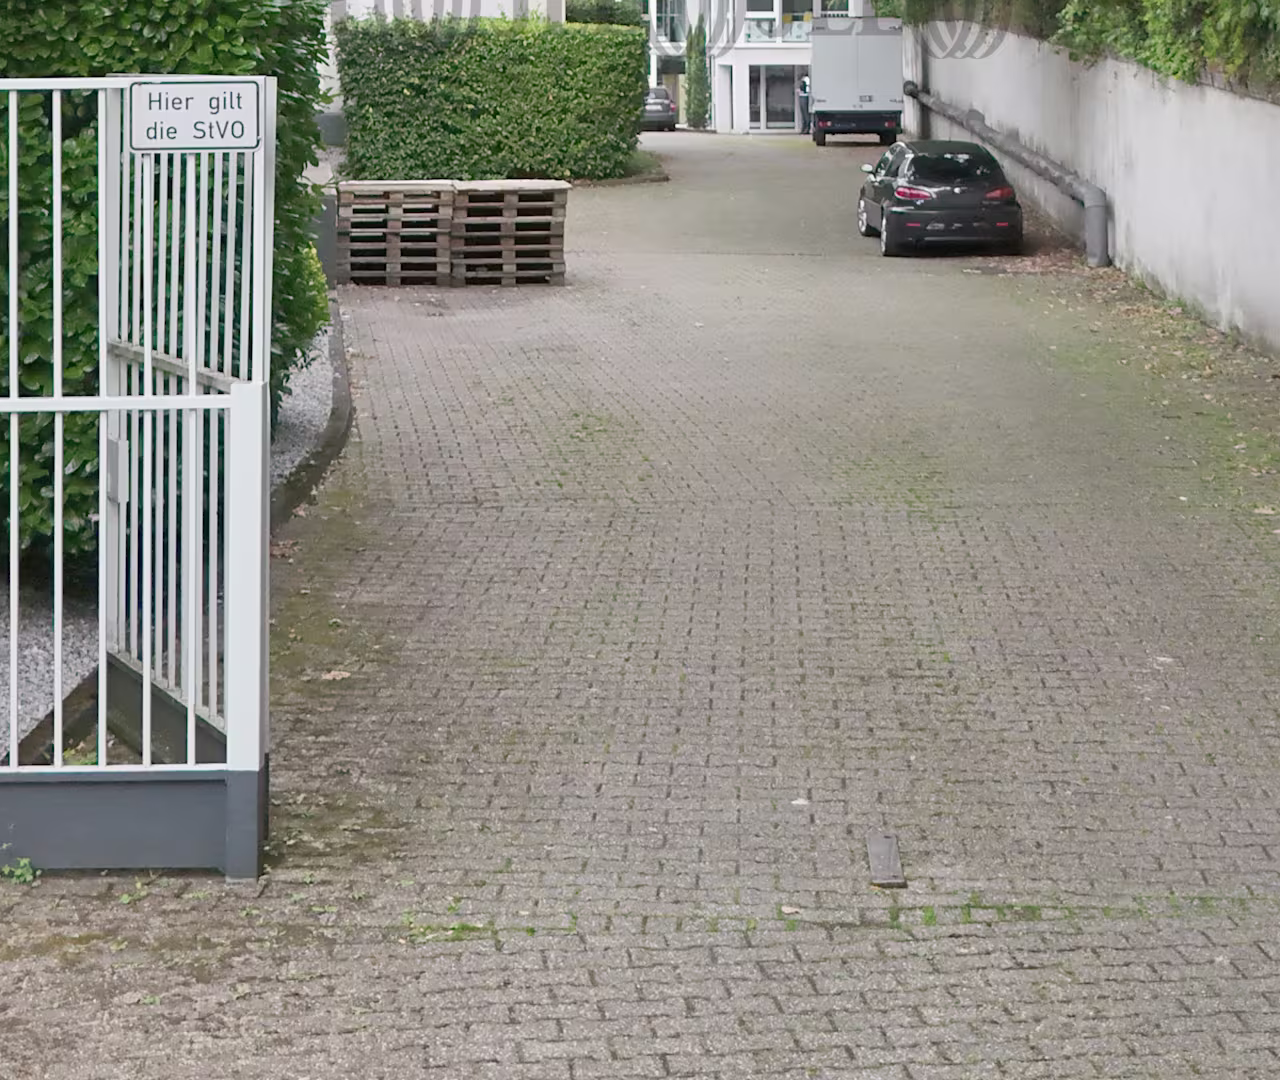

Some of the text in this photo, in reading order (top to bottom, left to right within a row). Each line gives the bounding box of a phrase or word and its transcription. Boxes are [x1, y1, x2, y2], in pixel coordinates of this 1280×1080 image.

[148, 91, 243, 115] Hier gilt
[146, 120, 245, 140] die StVO
